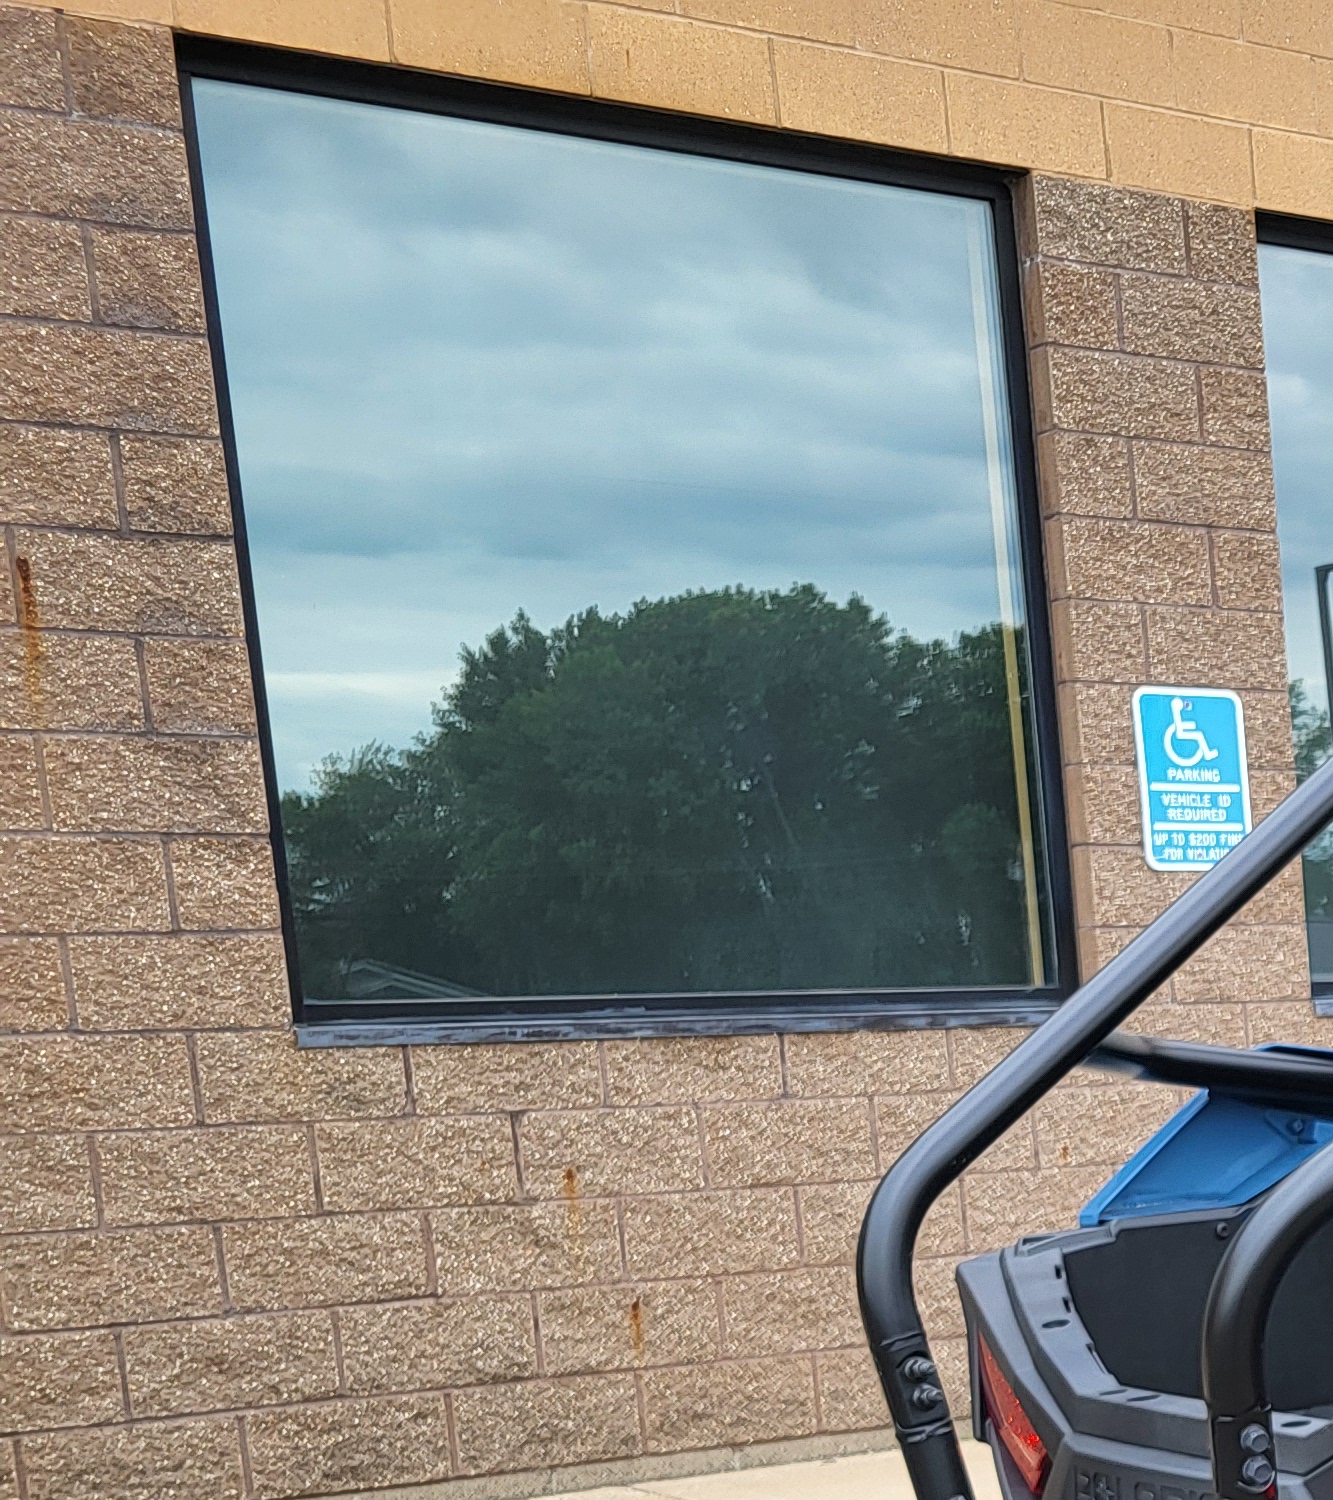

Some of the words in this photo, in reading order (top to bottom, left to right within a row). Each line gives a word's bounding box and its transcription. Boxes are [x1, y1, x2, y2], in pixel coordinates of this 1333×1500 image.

[1166, 767, 1221, 783] PARKING
[1160, 793, 1212, 807] VEHICLE
[1217, 793, 1232, 808] ID
[1166, 807, 1227, 822] REQUIRED
[1153, 832, 1169, 846] UP
[1170, 832, 1186, 846] TO
[1188, 833, 1217, 846] $200
[1163, 847, 1184, 860] FOR
